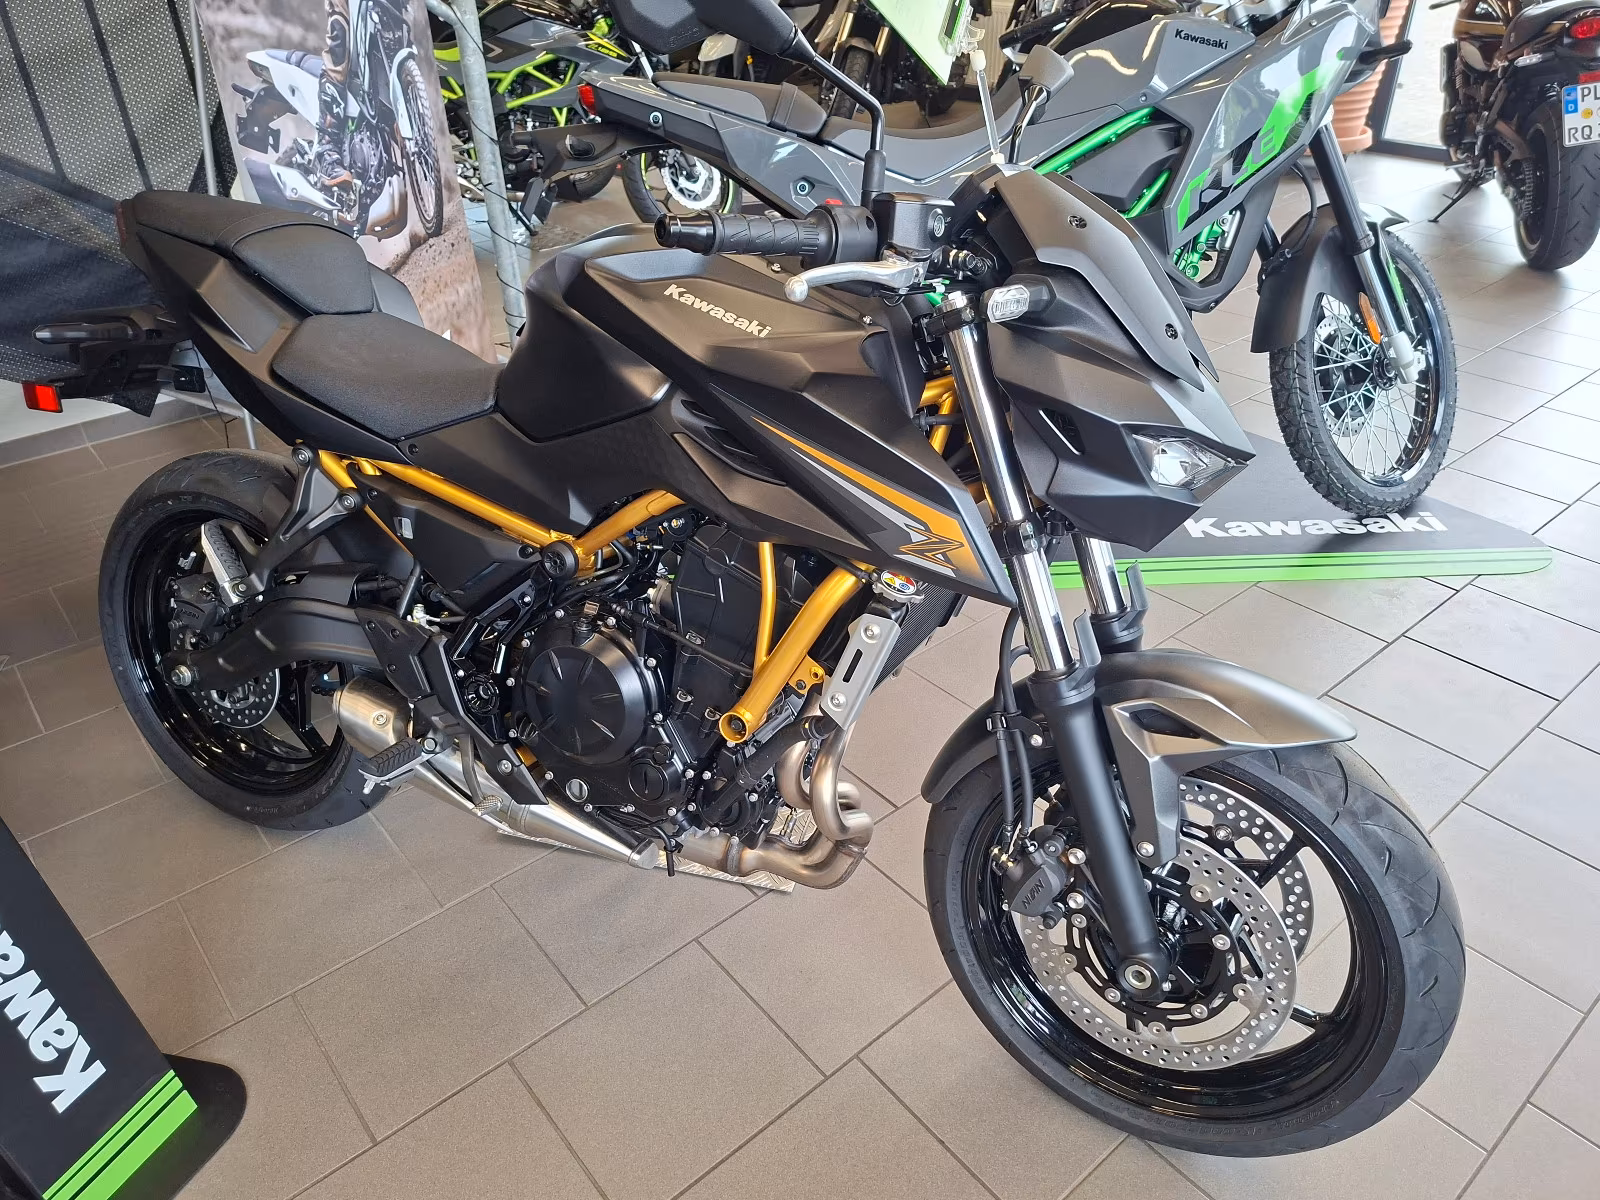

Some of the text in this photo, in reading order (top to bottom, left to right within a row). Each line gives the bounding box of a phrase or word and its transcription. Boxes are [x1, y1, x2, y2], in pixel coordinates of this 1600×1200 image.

[1174, 28, 1229, 50] Kawasaki
[663, 283, 773, 338] Kawasaki
[1183, 511, 1449, 538] Kawasaki
